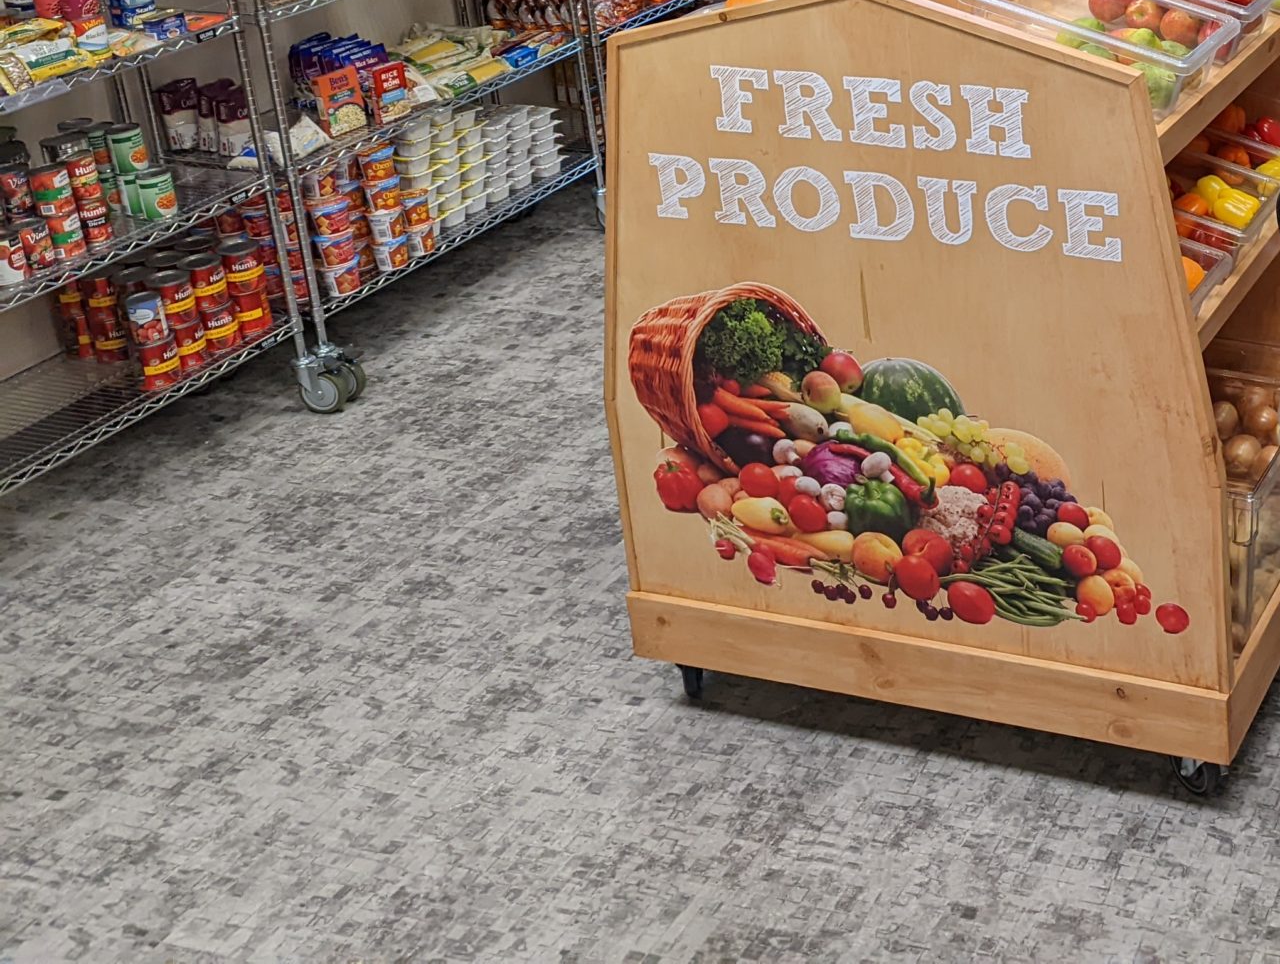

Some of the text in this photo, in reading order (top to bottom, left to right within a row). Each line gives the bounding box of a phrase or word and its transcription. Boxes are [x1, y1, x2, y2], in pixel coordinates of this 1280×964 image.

[381, 70, 398, 79] RICE
[383, 79, 400, 89] RONI
[709, 64, 1032, 159] FRESH
[647, 152, 1123, 263] PRODUCE
